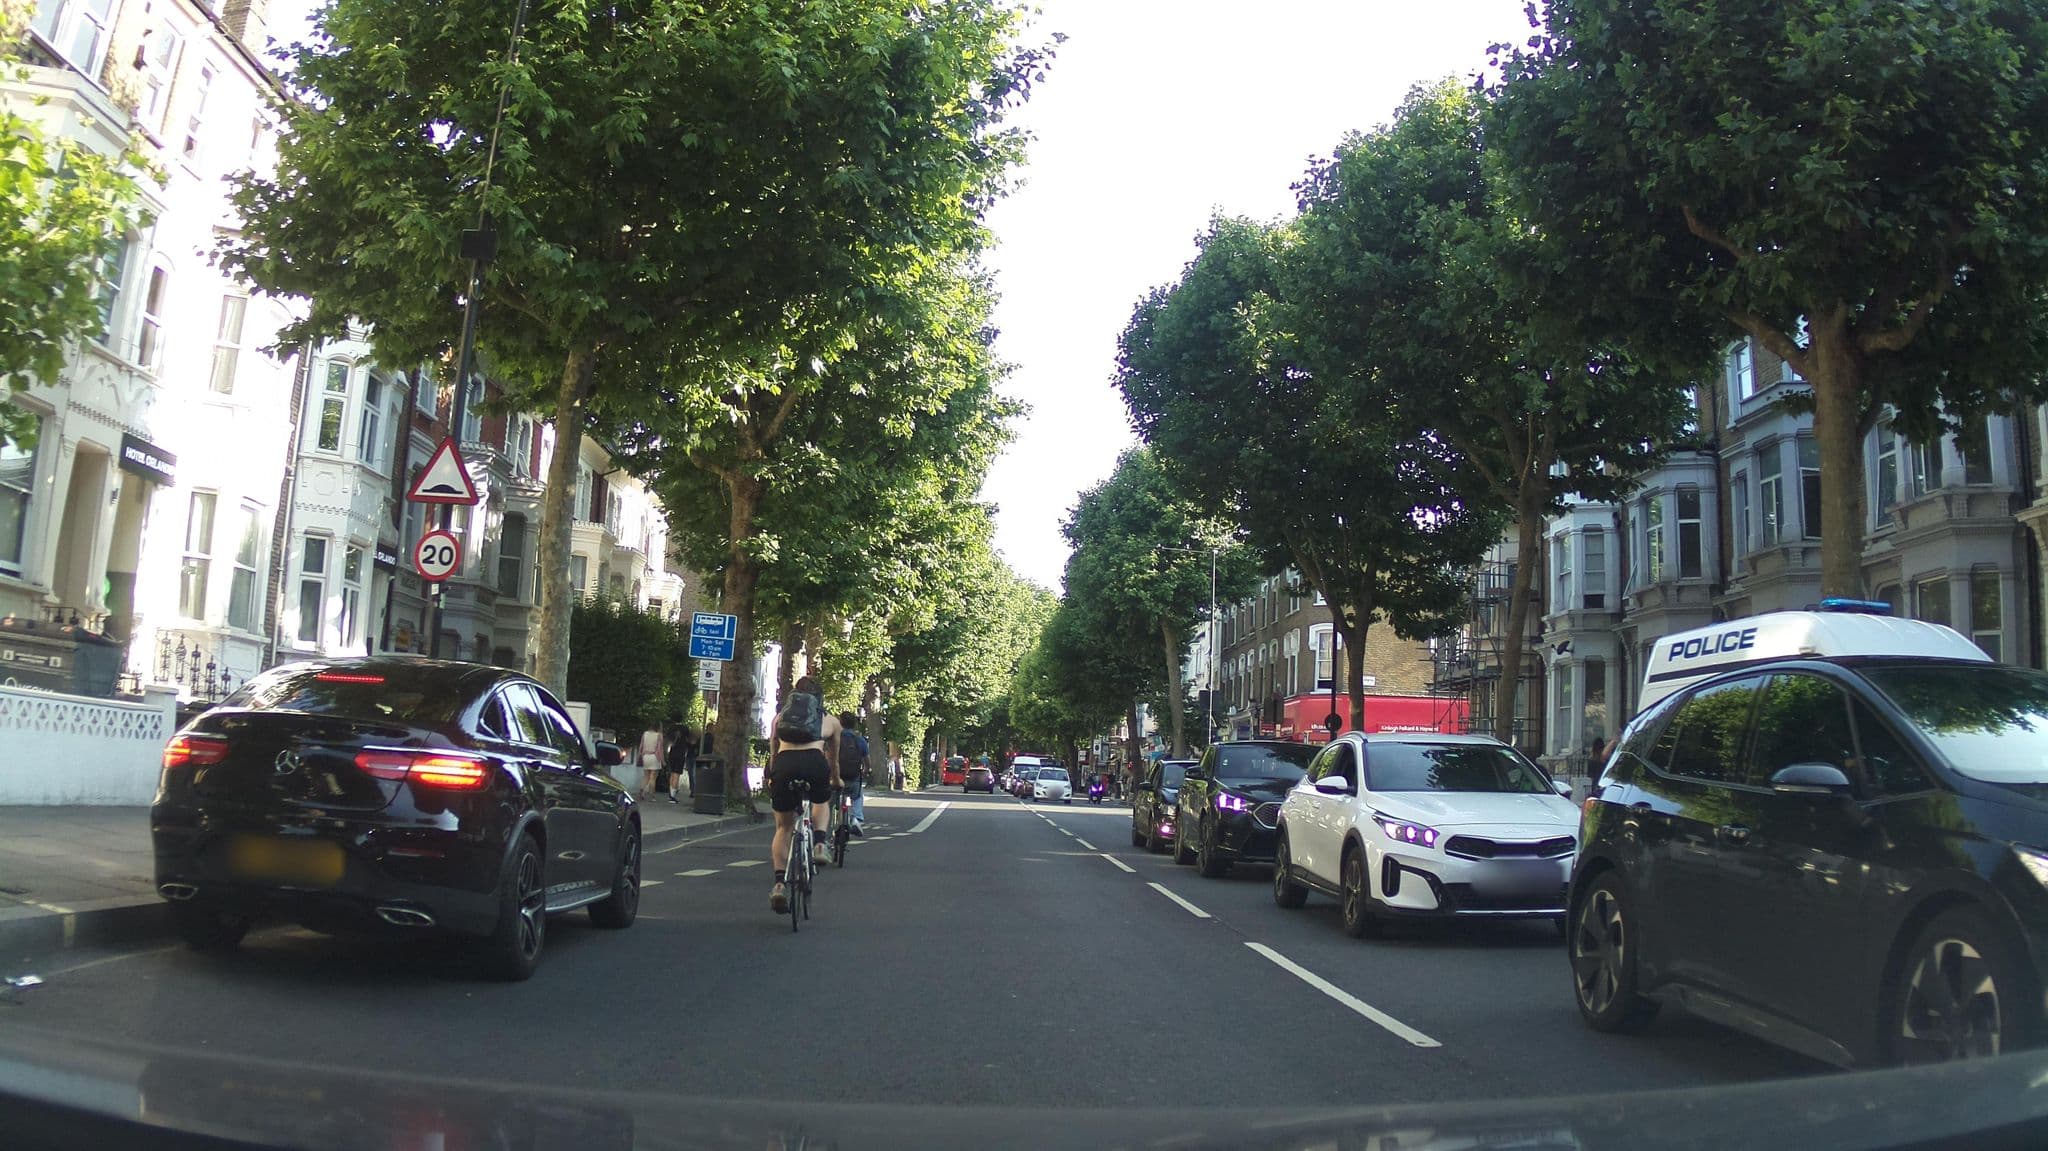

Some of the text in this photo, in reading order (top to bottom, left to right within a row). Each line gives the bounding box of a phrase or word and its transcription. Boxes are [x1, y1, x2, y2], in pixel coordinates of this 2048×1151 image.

[125, 446, 146, 465] HOTEL
[422, 544, 454, 567] 20
[1668, 627, 1758, 662] POLICE
